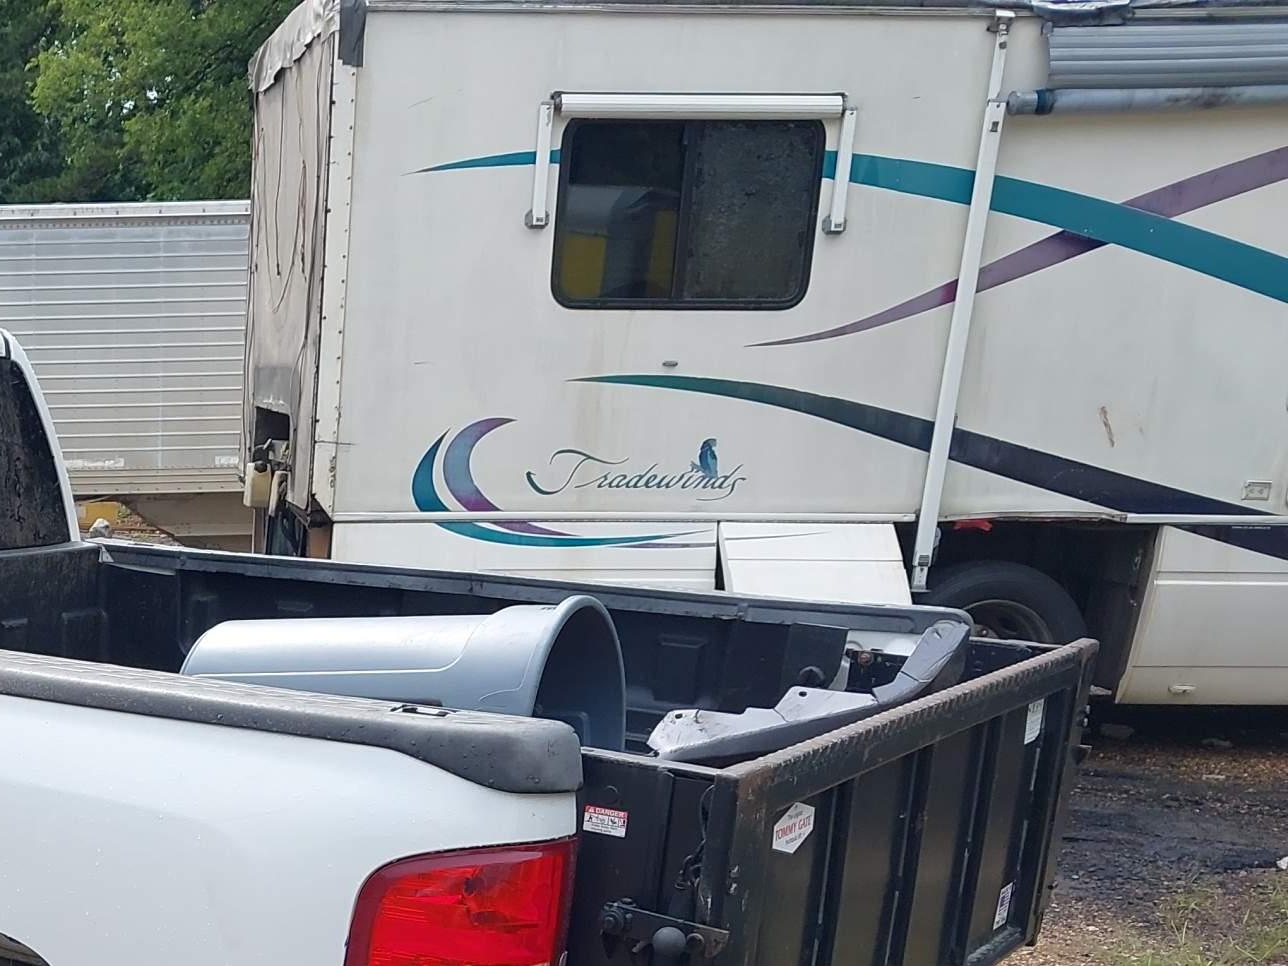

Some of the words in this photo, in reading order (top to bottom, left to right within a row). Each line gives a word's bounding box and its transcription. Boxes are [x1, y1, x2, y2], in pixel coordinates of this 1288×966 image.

[526, 448, 747, 501] Tradewinds
[595, 806, 625, 819] DANGER
[775, 821, 798, 841] TOMMY
[798, 815, 812, 831] GATE
